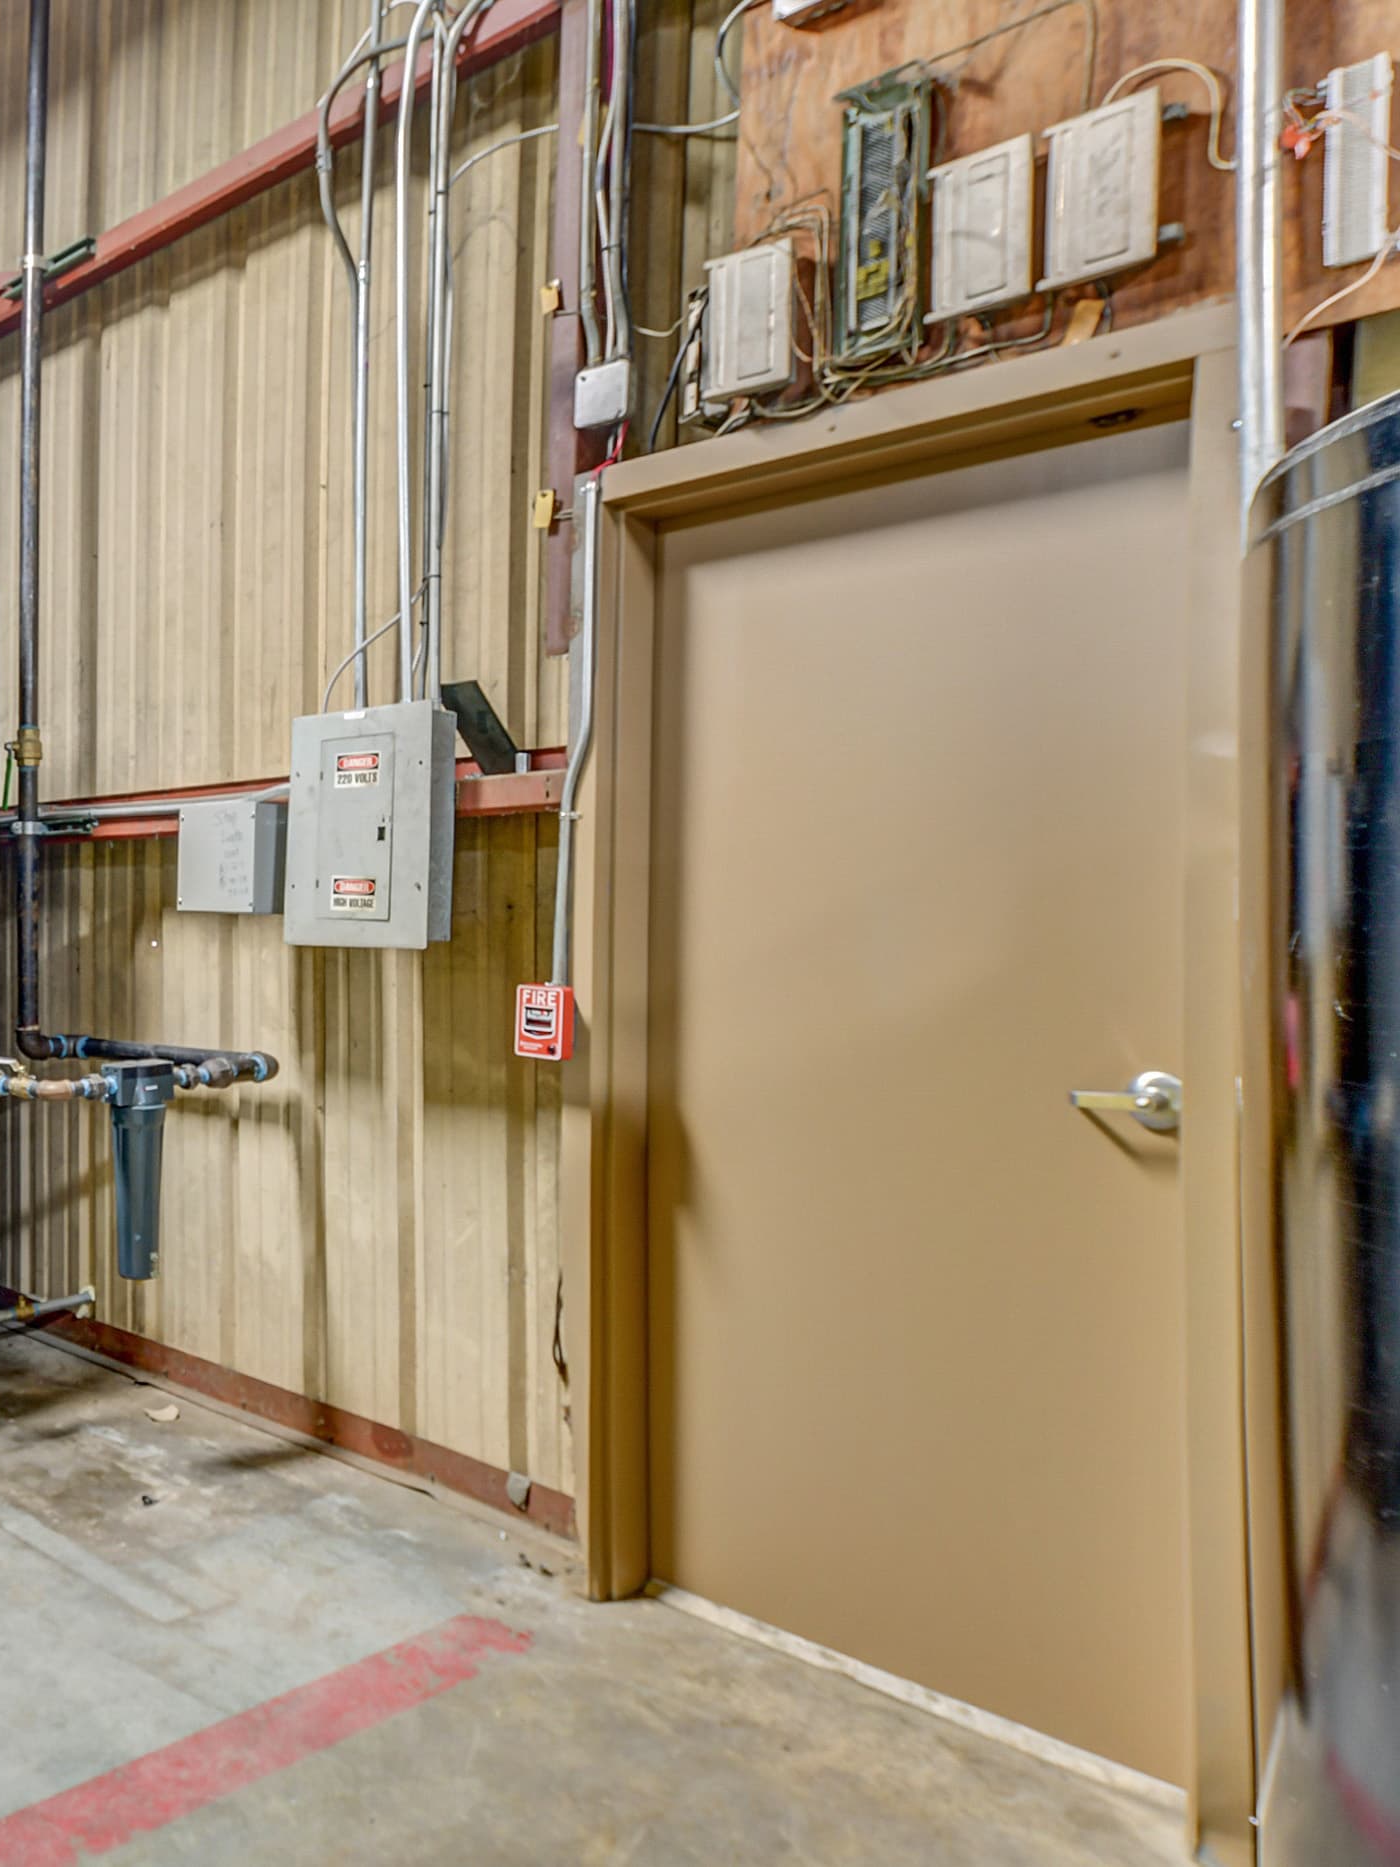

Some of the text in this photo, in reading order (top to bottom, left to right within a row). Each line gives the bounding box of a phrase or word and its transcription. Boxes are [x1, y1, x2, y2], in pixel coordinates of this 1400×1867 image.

[337, 771, 378, 785] 220 VOLTS
[349, 898, 374, 909] VOLTAGE
[522, 989, 557, 1007] FIRE
